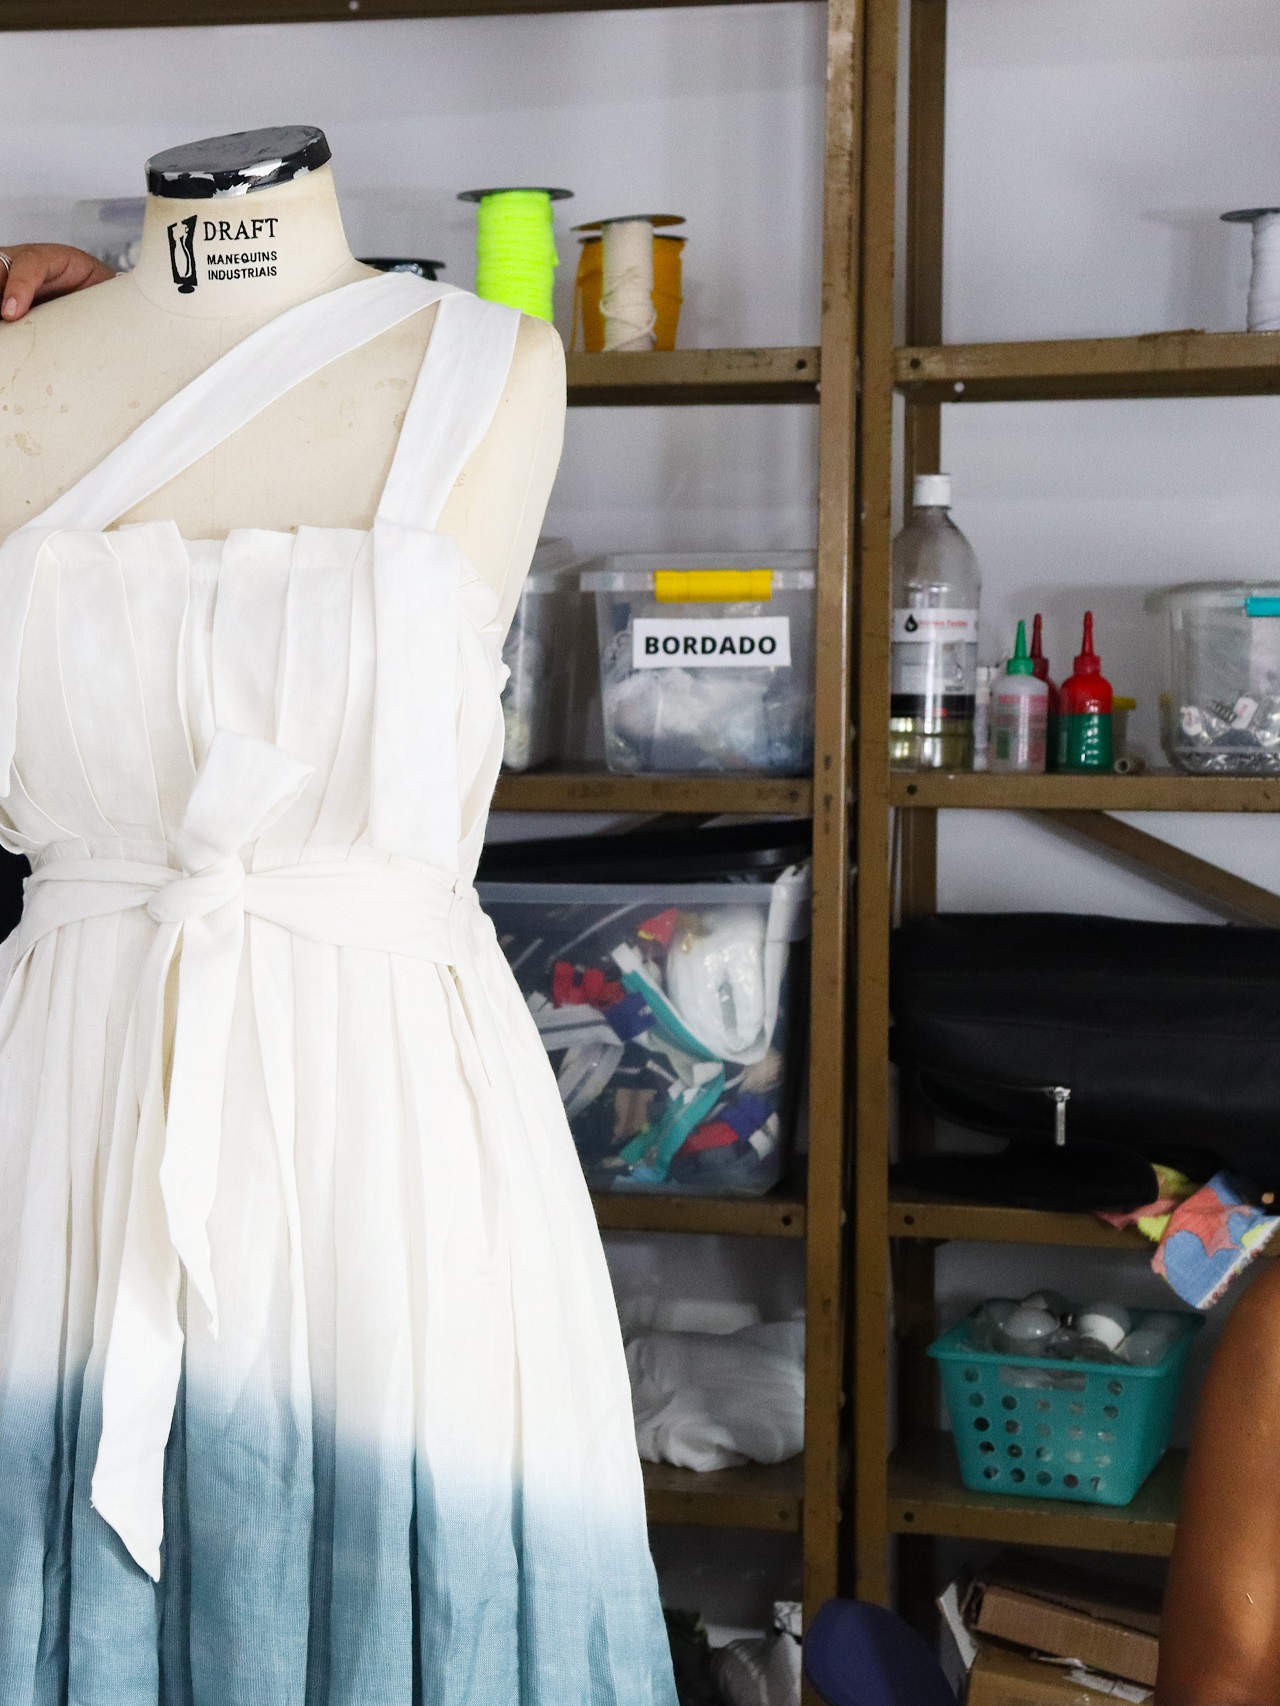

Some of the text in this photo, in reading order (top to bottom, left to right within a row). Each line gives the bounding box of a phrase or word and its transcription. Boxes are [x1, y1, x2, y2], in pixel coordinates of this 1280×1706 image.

[203, 218, 279, 241] DRAFT
[207, 250, 278, 265] MANEQUINS
[208, 266, 277, 280] INDUSTRIAIS
[645, 636, 776, 655] BORDADO
